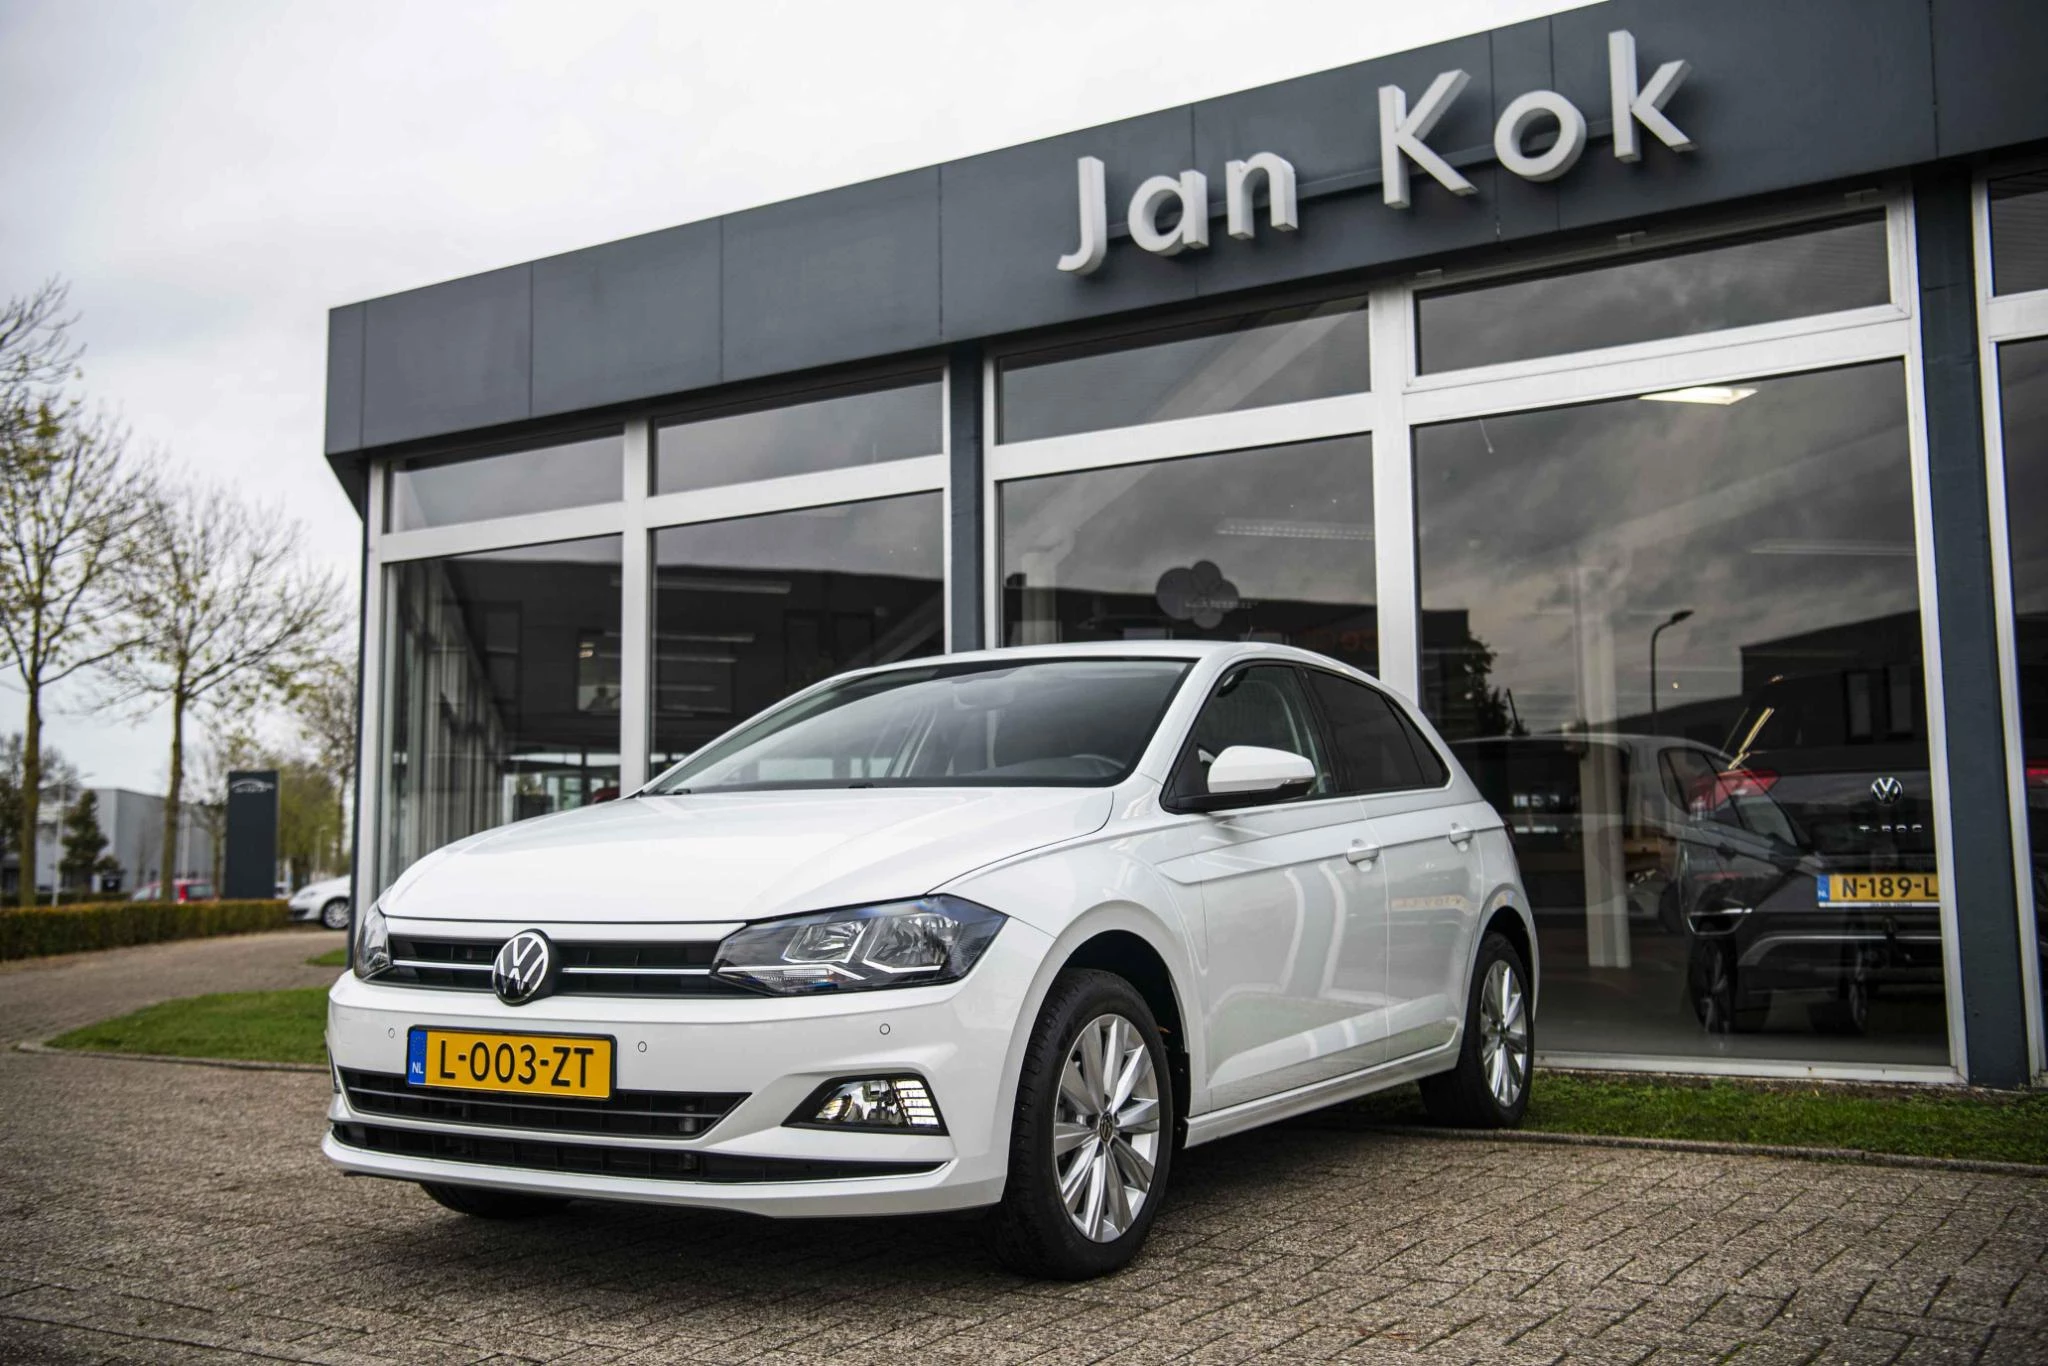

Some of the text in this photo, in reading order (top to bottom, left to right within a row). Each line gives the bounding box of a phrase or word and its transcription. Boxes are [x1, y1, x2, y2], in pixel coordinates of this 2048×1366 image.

[1057, 29, 1695, 276] Jan Kok
[1842, 876, 1939, 899] N-189-L
[411, 1040, 595, 1089] NL L-003-ZT
